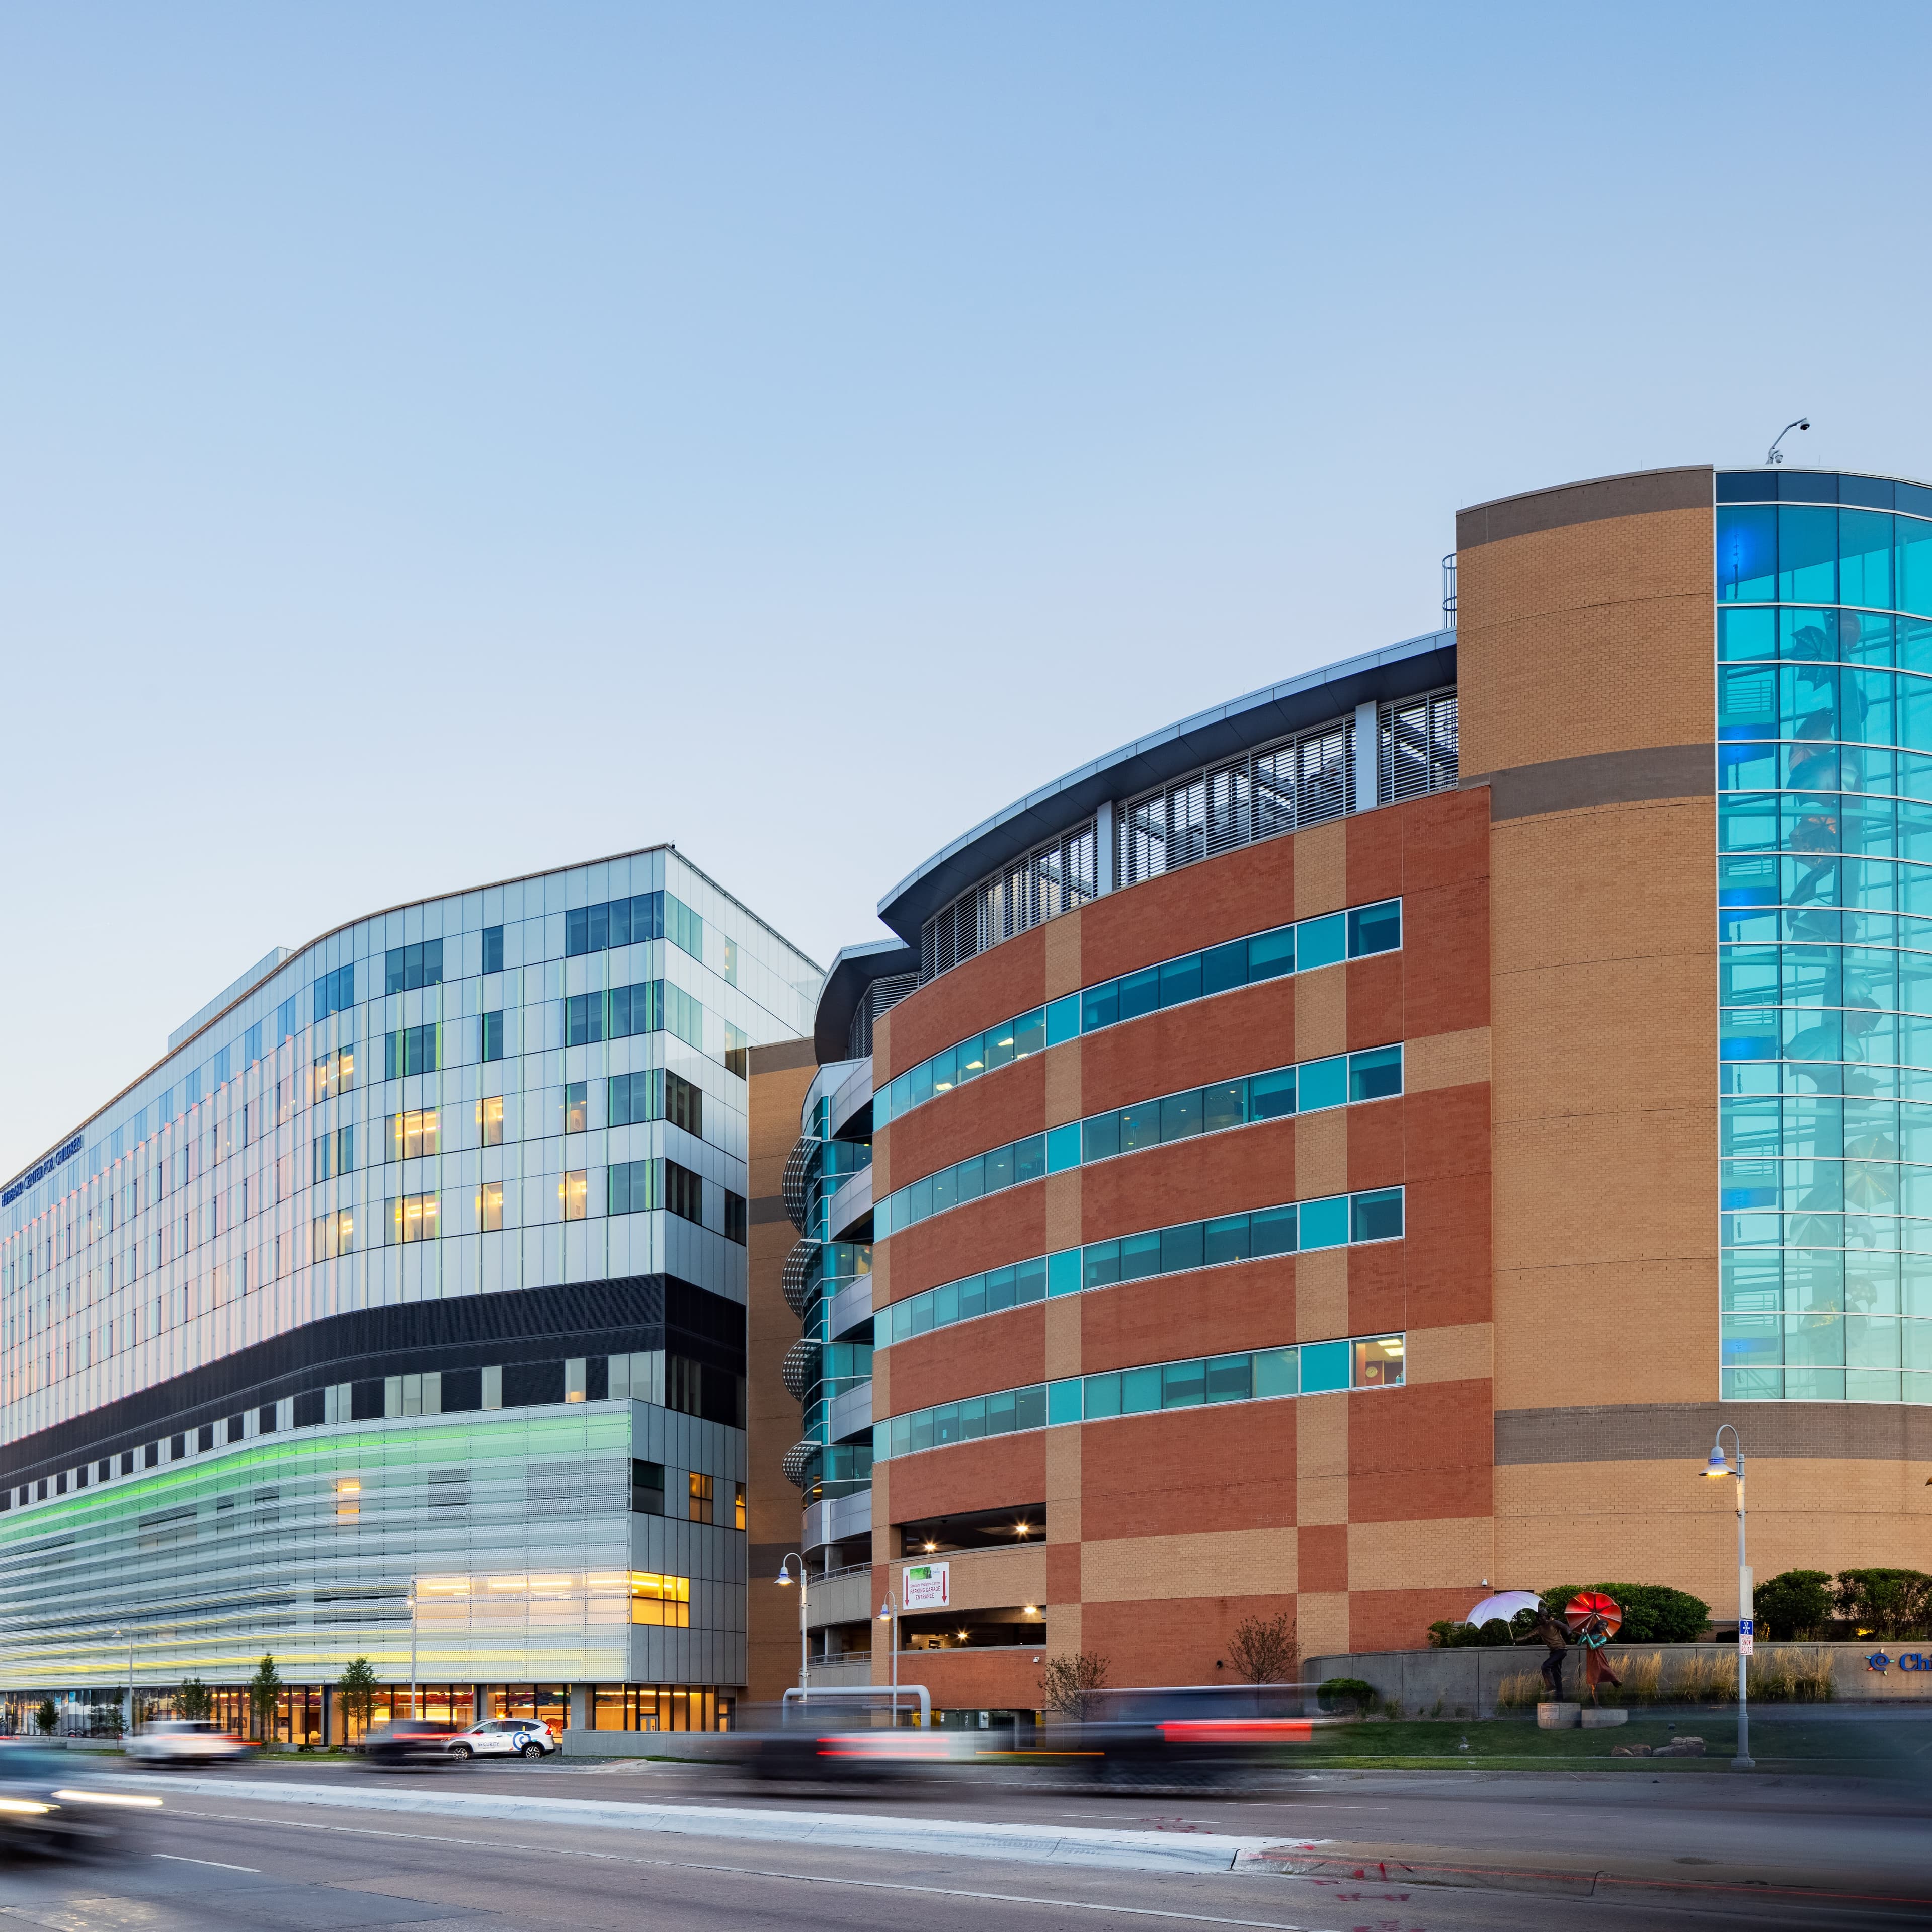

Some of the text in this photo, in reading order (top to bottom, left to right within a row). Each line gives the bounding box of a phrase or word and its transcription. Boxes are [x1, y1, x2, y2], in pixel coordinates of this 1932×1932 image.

[2, 1134, 82, 1207] HUBBARD CENTER FOR CHILDREN
[1899, 1653, 1932, 1671] Ch
